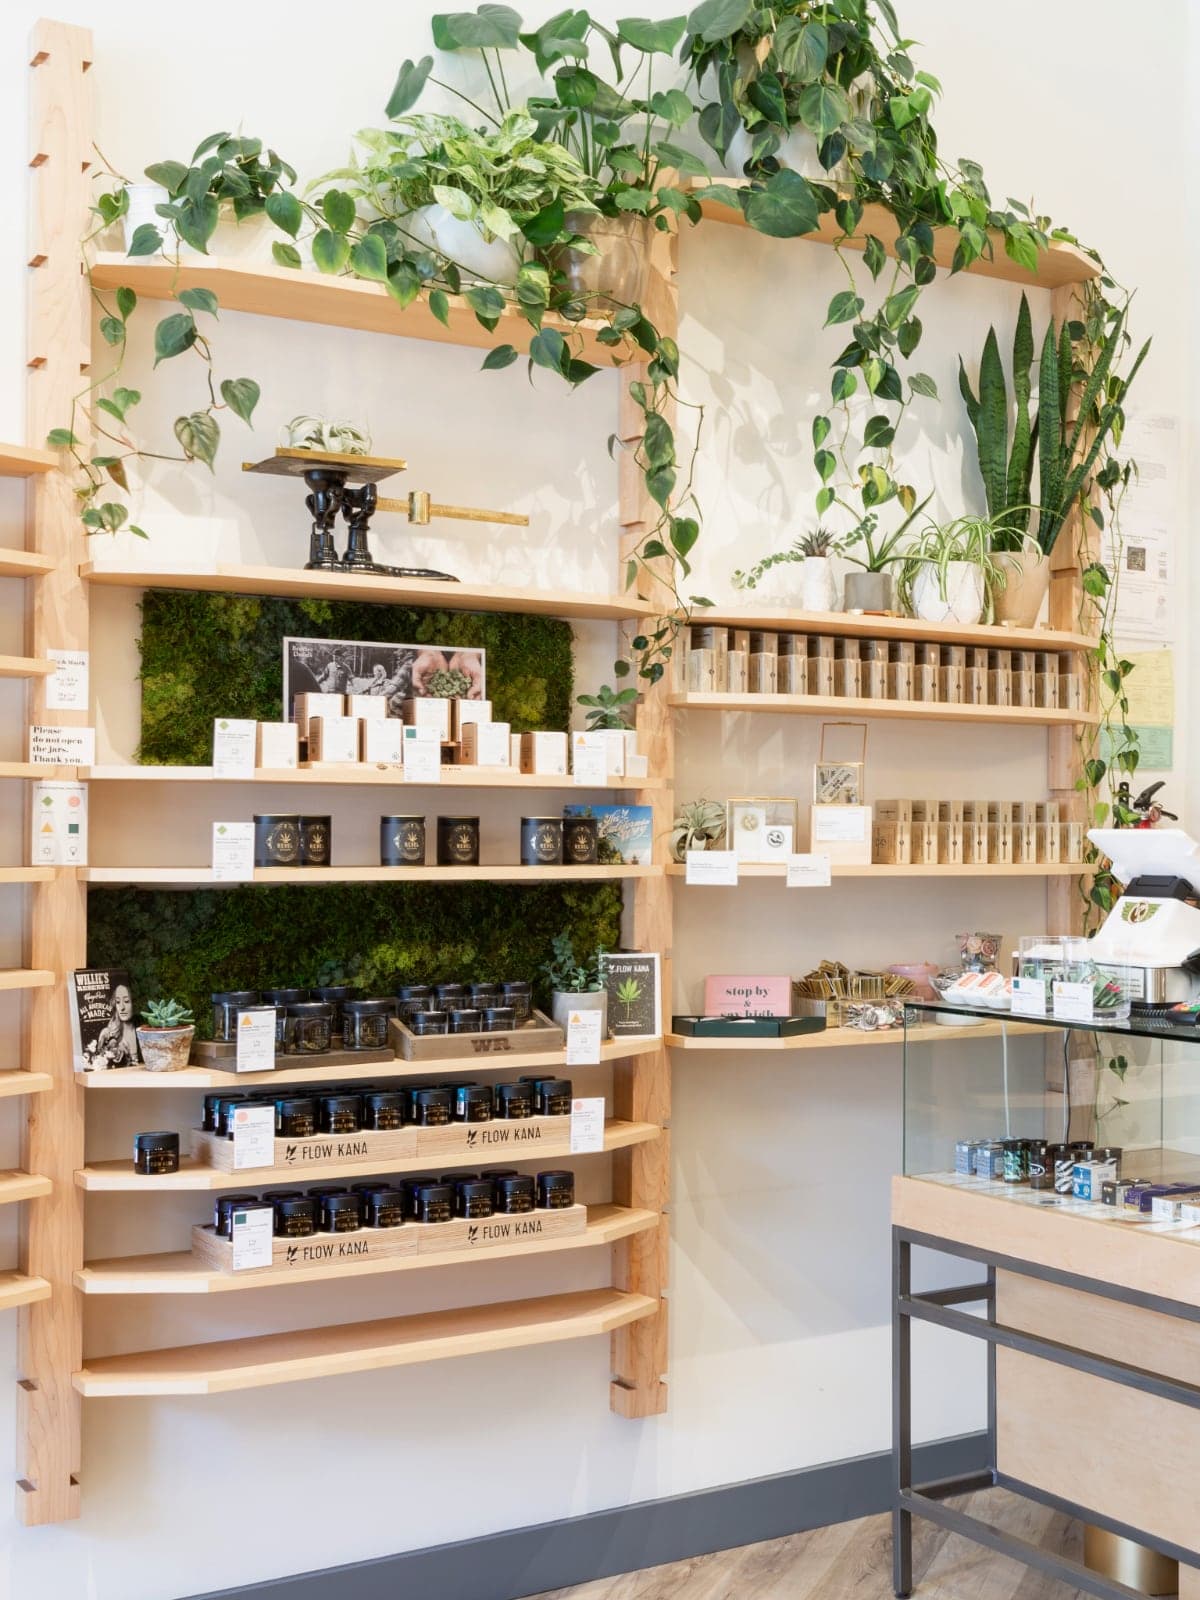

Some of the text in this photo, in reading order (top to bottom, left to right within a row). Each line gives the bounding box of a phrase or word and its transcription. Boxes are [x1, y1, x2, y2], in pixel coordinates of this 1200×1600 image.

[33, 726, 62, 734] Please
[34, 755, 62, 763] Thank
[634, 965, 650, 973] KANA
[76, 972, 110, 986] WILLIE'S
[726, 986, 770, 998] stop by
[88, 1011, 106, 1019] MADE
[482, 1127, 542, 1145] FLOW KANA
[302, 1142, 368, 1160] FLOW KANA
[483, 1220, 543, 1240] FLOW KANA
[303, 1241, 369, 1260] FLOW KANA
